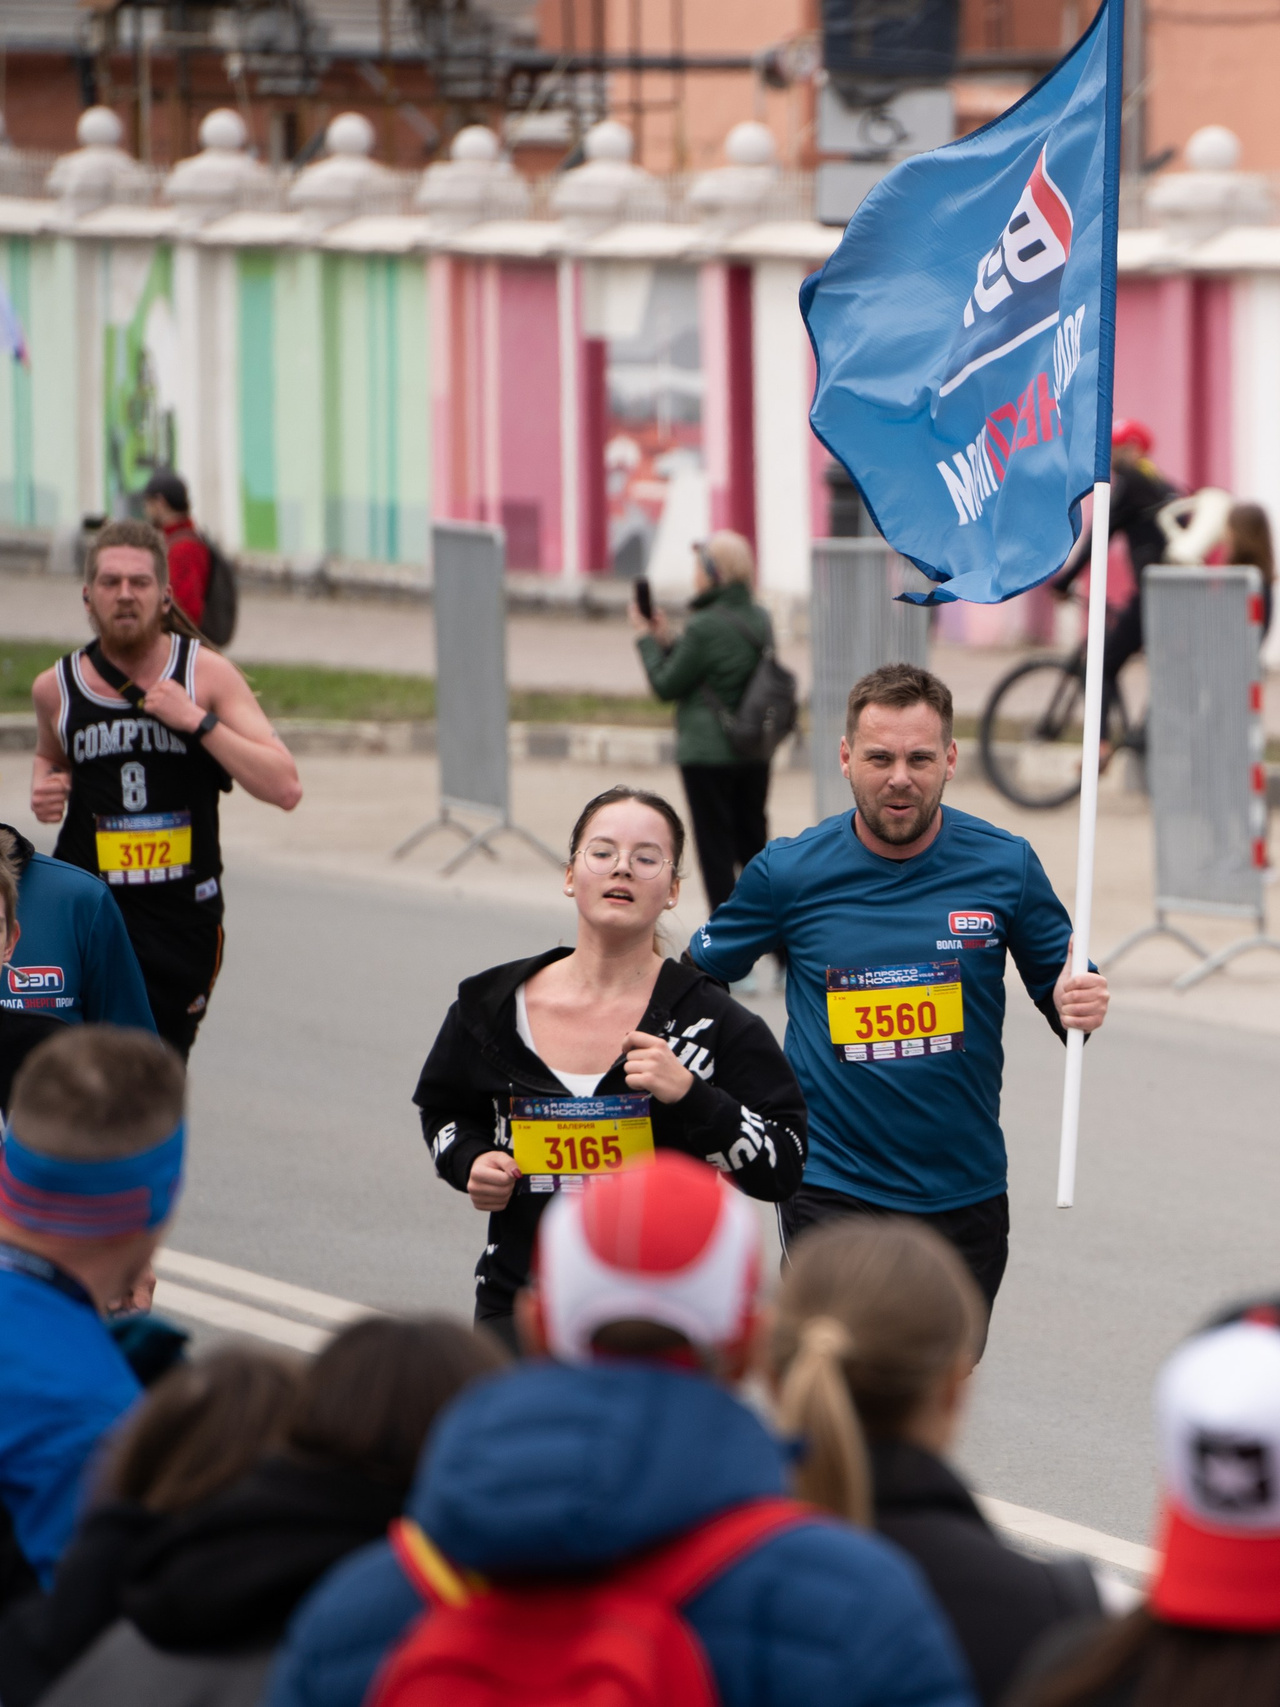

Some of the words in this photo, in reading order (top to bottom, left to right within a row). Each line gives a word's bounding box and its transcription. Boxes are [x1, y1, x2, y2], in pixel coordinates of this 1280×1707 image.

[120, 761, 148, 812] 8
[120, 841, 171, 867] 3172
[873, 968, 918, 977] ПРОСТО
[865, 974, 919, 985] КОСМОС
[855, 1001, 937, 1039] 3560
[558, 1101, 604, 1109] ПРОСТО
[550, 1108, 605, 1116] КОСМОС
[557, 1122, 595, 1130] ВАЛЕРИЯ
[544, 1135, 623, 1170] 3165
